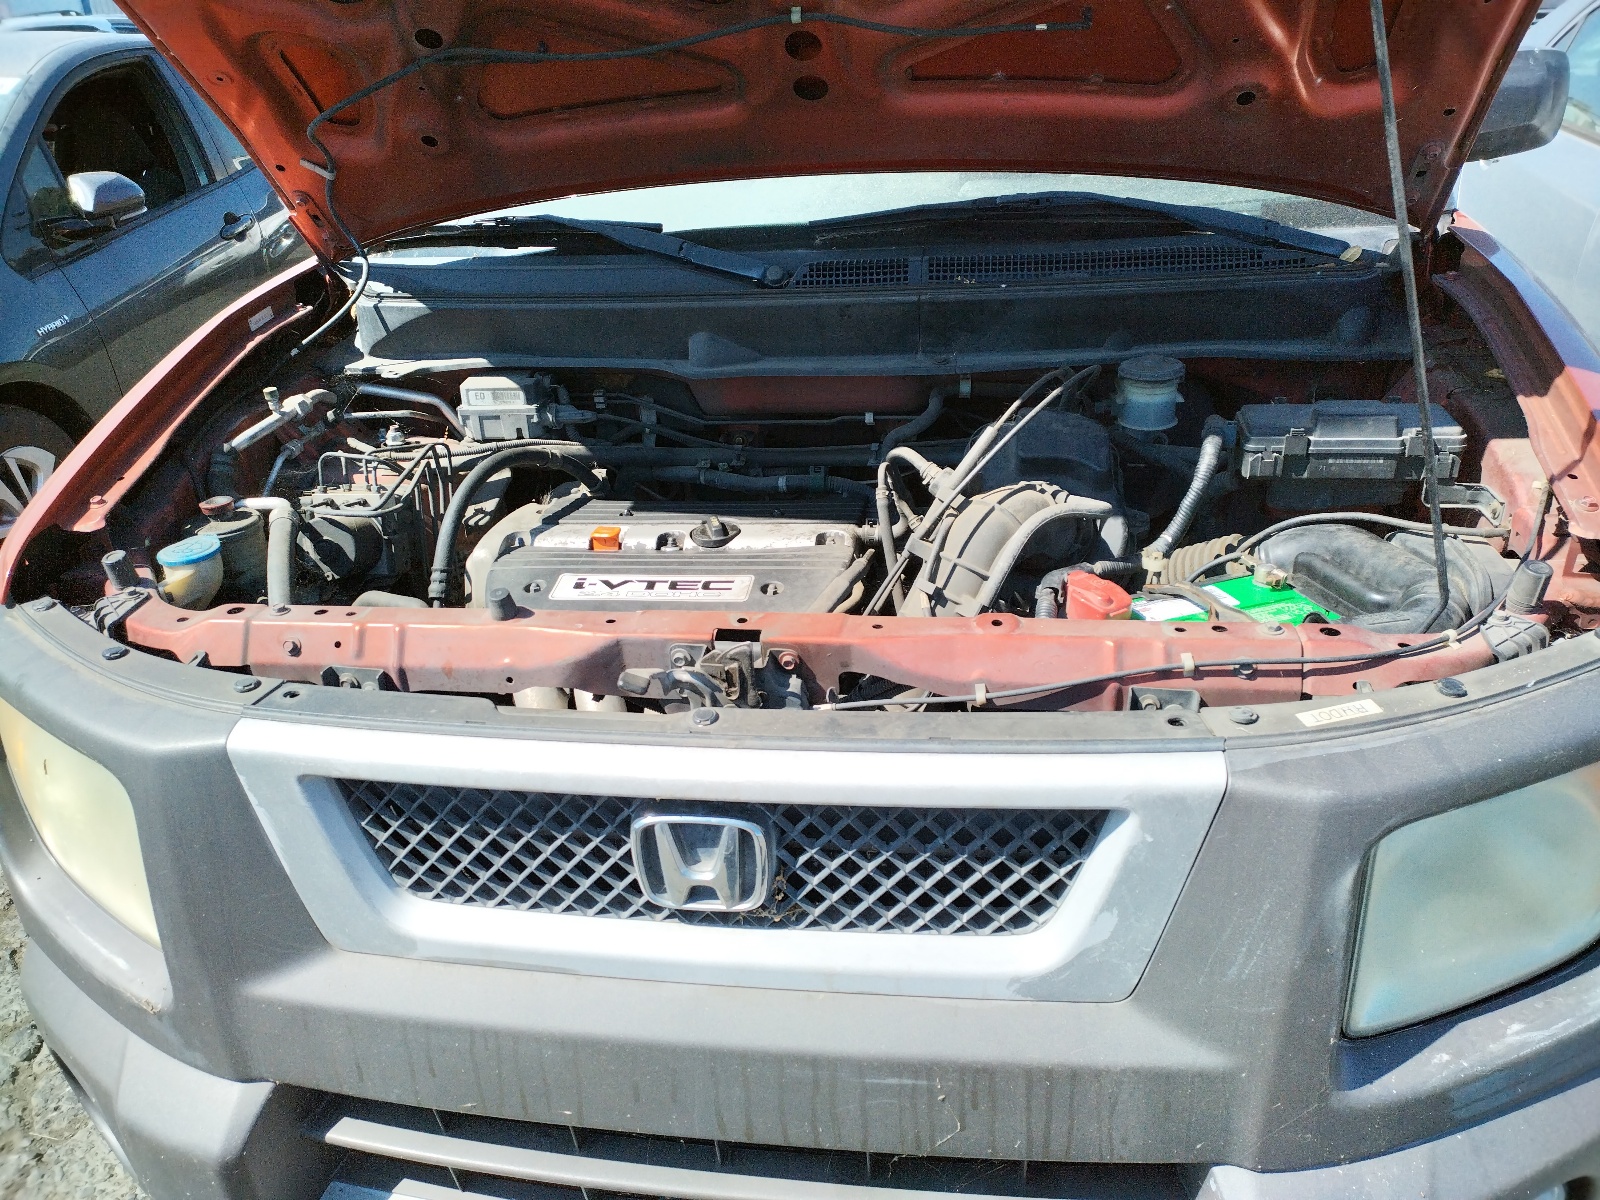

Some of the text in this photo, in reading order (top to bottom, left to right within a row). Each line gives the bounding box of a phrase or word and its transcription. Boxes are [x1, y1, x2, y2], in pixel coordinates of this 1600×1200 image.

[37, 317, 67, 336] HYBRID
[572, 577, 735, 591] i-VTEC
[625, 590, 722, 598] DOHC
